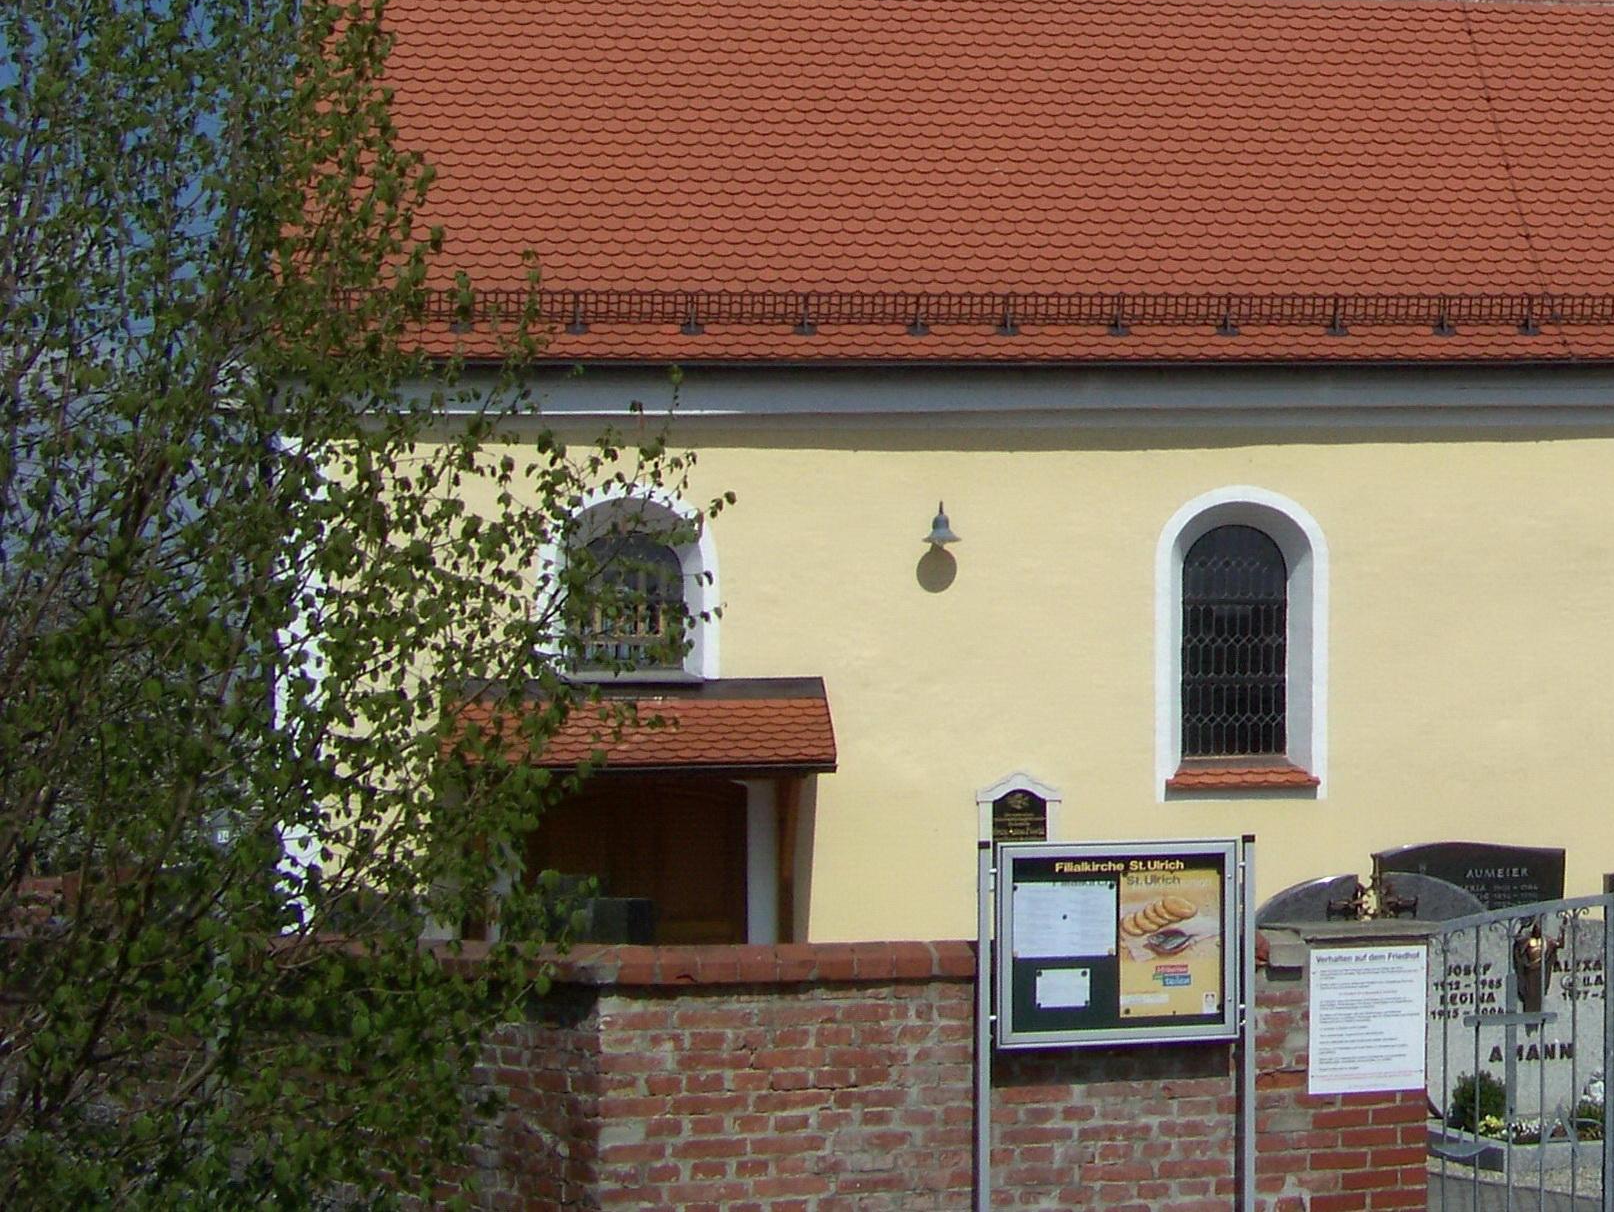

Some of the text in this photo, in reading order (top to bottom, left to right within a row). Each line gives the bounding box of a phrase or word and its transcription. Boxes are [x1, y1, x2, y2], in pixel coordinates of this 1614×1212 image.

[1055, 861, 1125, 873] Filialkirche
[1316, 951, 1420, 963] Verhalten auf dem Friedhof
